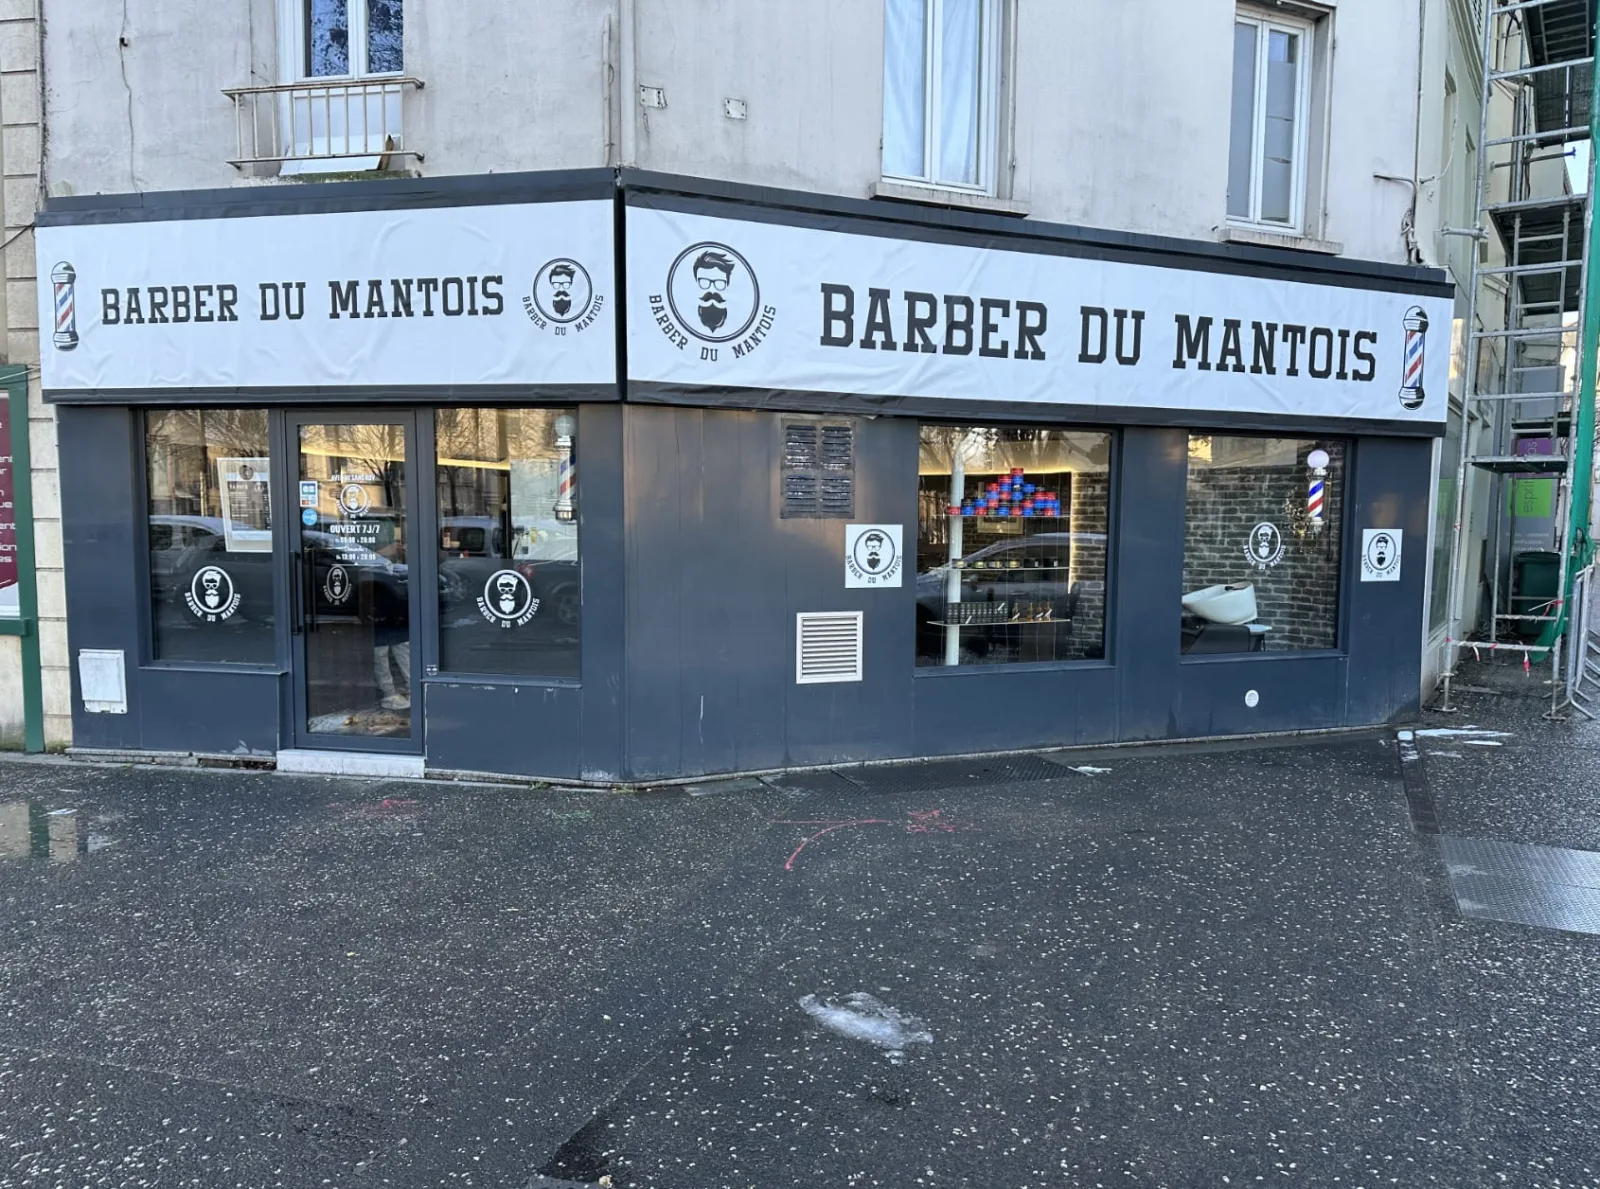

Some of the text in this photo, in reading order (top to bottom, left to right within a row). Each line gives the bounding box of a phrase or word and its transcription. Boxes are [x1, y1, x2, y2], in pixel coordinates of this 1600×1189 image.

[101, 274, 504, 325] BARBER DU MANTOIS
[522, 294, 604, 336] BARBER DU MANTOIS
[649, 294, 776, 362] BARBER DU MANTOIS
[821, 282, 1378, 382] BARBER DU MANTOIS
[330, 524, 380, 534] OUVERT 7J/7
